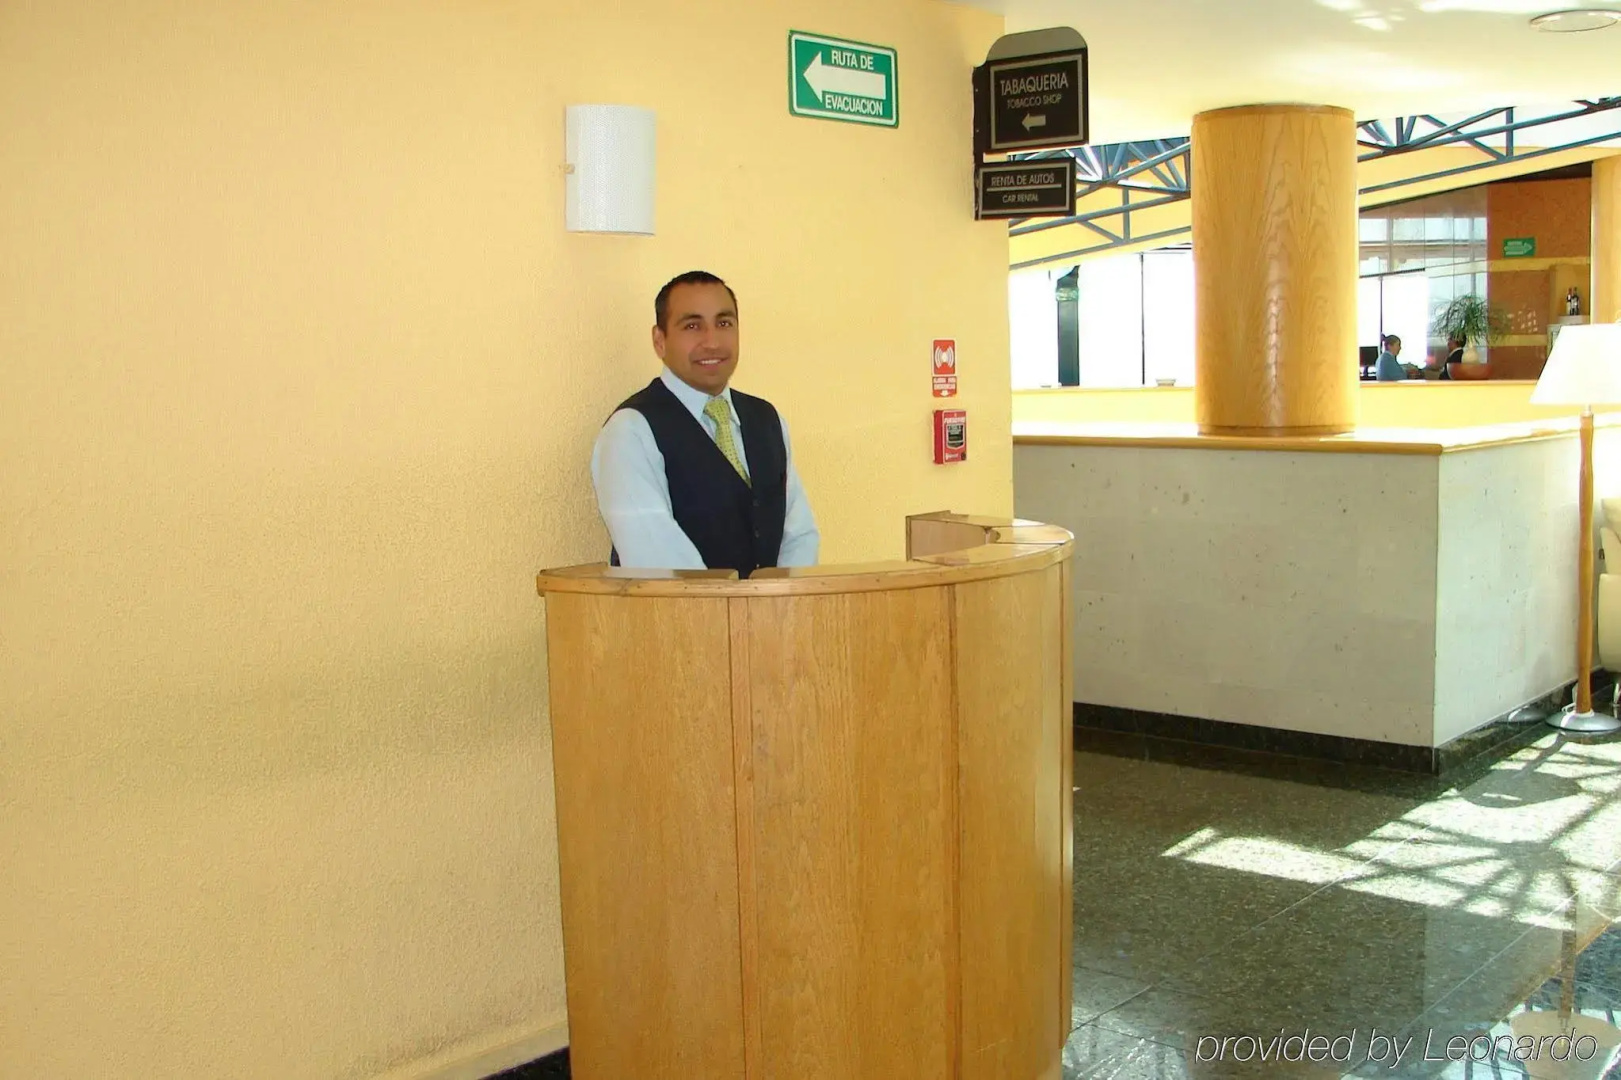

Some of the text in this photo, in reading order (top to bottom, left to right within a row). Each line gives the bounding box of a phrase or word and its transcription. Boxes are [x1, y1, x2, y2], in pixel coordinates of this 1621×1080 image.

[831, 50, 874, 70] RUTA DE
[1000, 72, 1069, 96] TABAQUERIA
[825, 94, 883, 116] EVACUACION
[1007, 93, 1062, 109] TOBACCO SHOP
[991, 173, 1055, 187] RENTA DE AUTOS
[1002, 193, 1039, 203] CAR RENTAL
